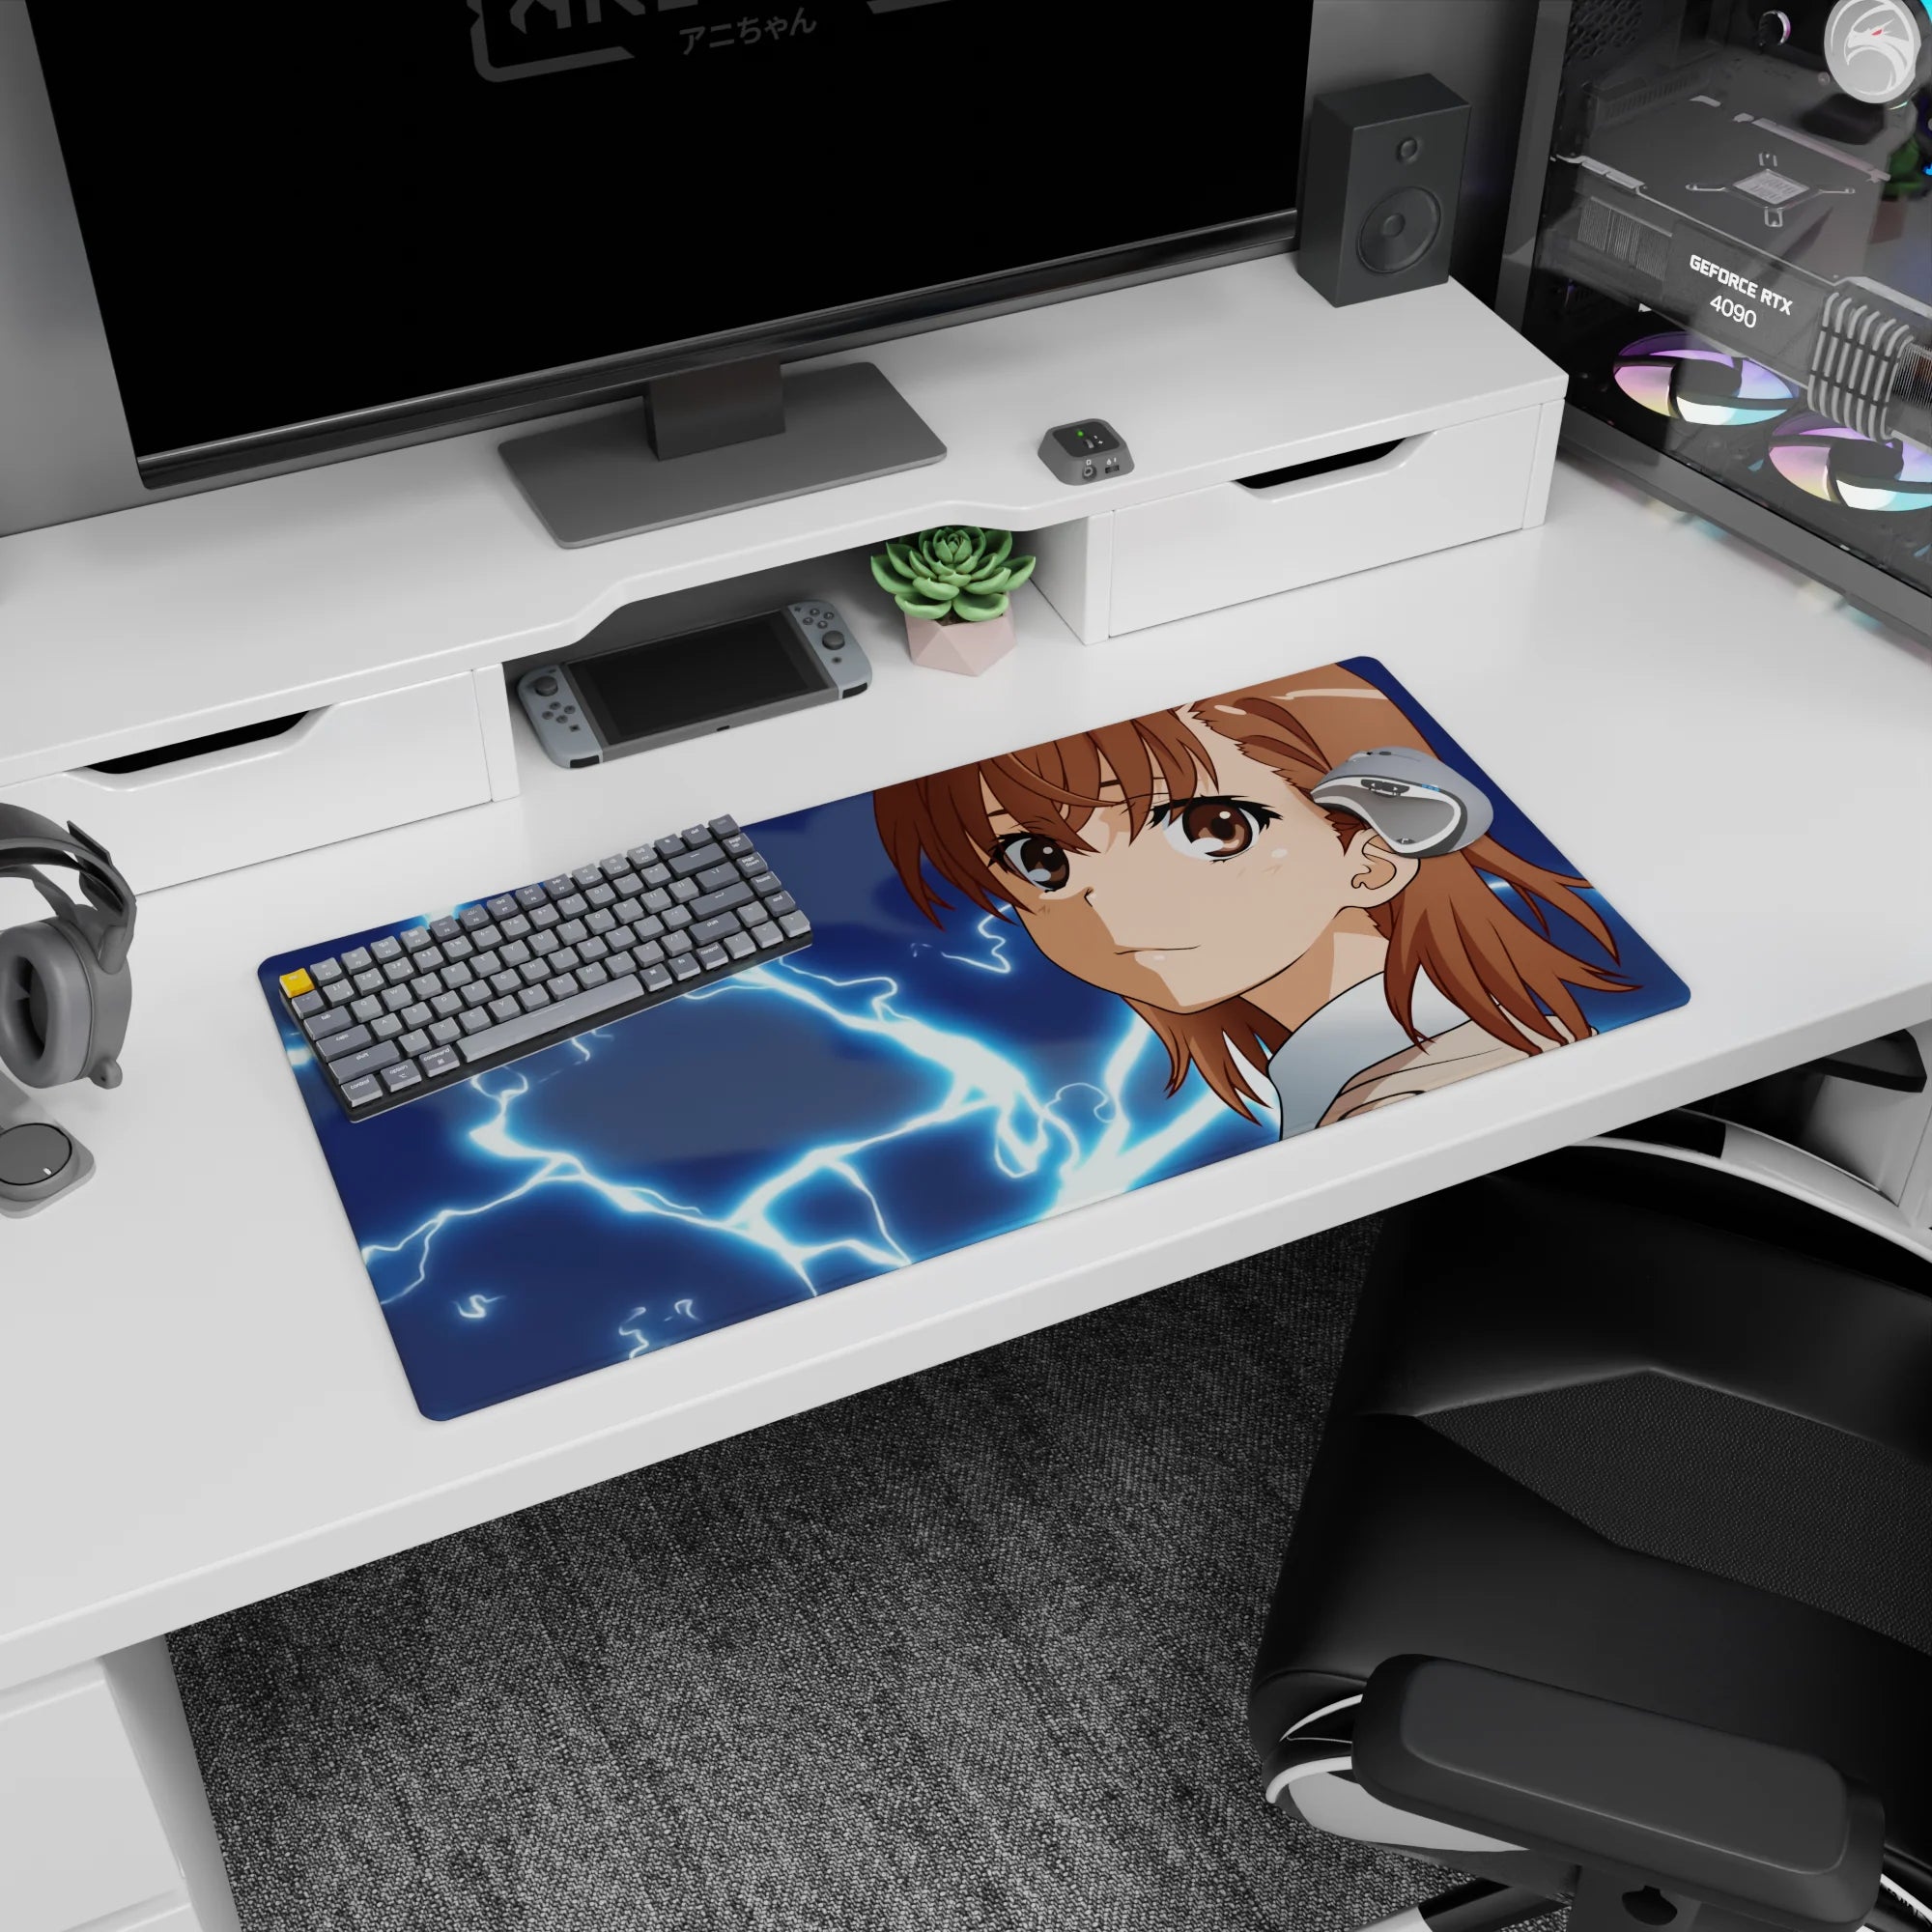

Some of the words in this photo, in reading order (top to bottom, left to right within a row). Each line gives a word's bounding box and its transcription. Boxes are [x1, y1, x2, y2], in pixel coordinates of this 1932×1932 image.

[679, 8, 816, 55] アニちゃん
[1690, 254, 1758, 298] GEFORCE
[1761, 288, 1794, 316] RTX
[1710, 295, 1757, 328] 4090
[700, 945, 719, 955] control
[423, 1048, 450, 1062] command
[389, 1065, 409, 1075] option
[350, 1079, 370, 1090] control
